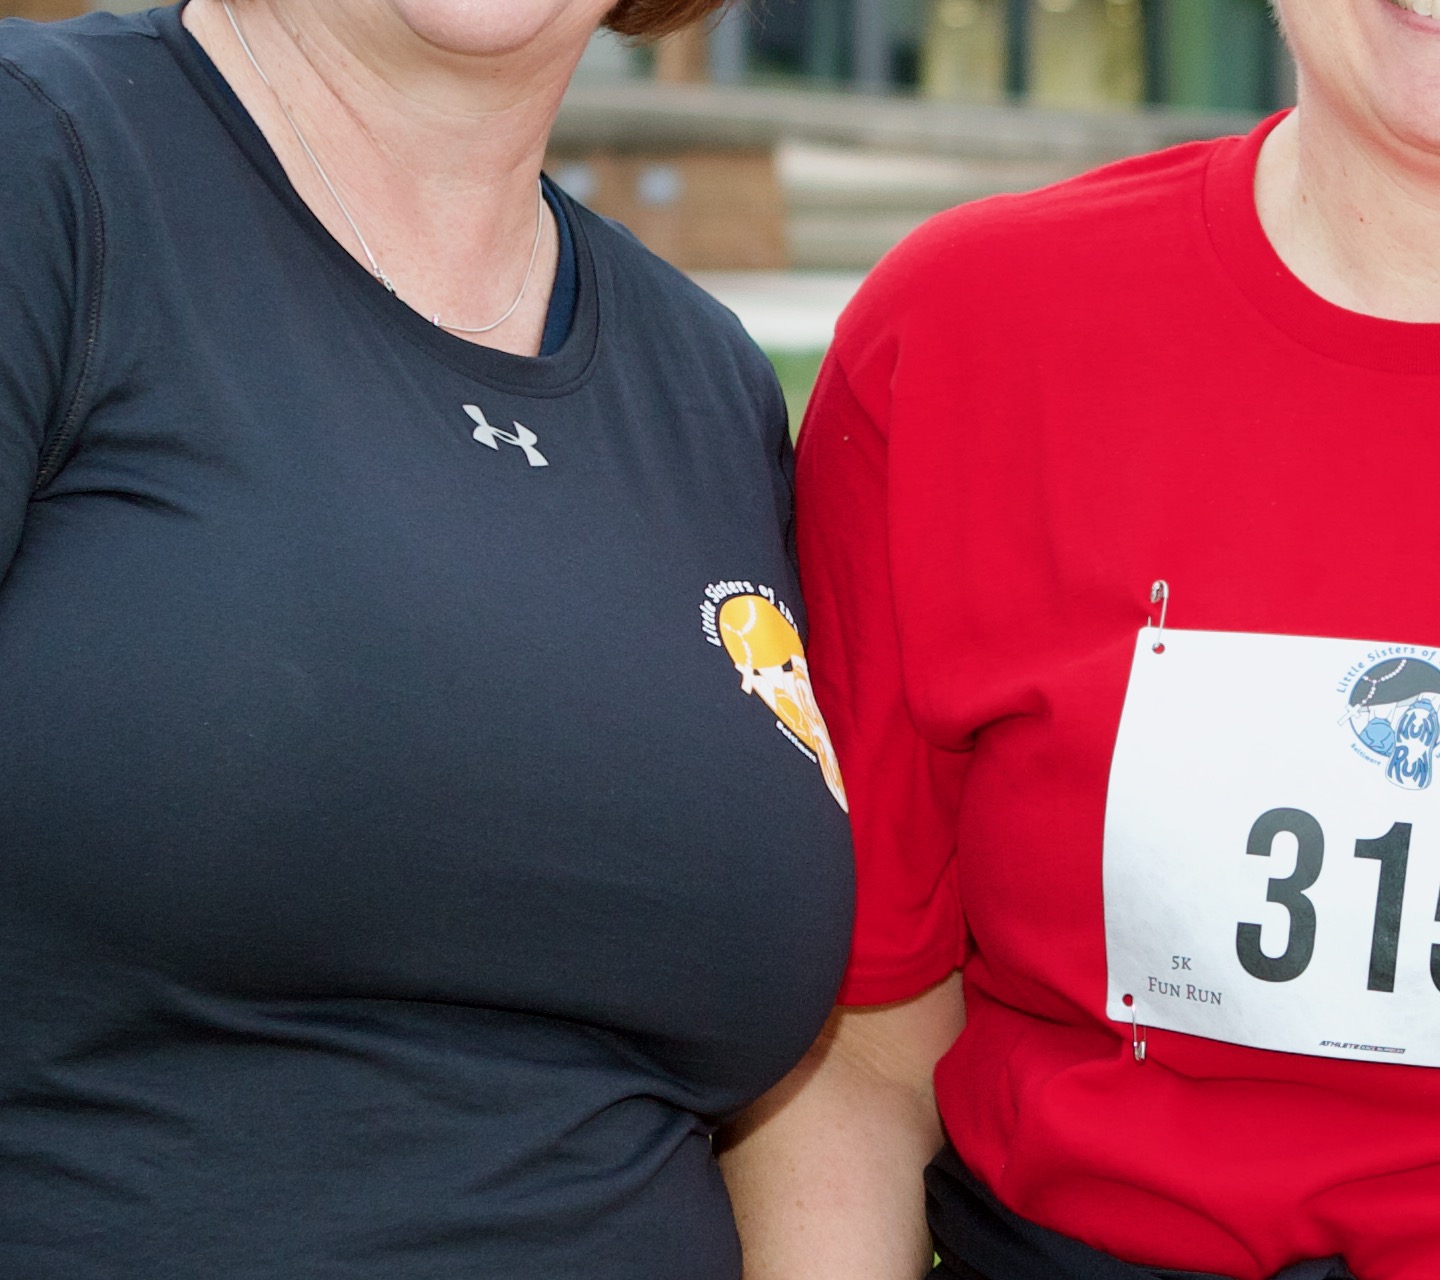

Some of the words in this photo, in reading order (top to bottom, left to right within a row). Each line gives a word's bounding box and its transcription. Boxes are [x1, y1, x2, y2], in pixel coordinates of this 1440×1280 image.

[704, 580, 755, 604] Sisters
[758, 584, 775, 605] of
[1337, 662, 1364, 693] Little
[1367, 646, 1415, 662] Sisters
[1422, 650, 1436, 660] of
[1387, 745, 1428, 788] RUN
[1171, 955, 1192, 971] 5K
